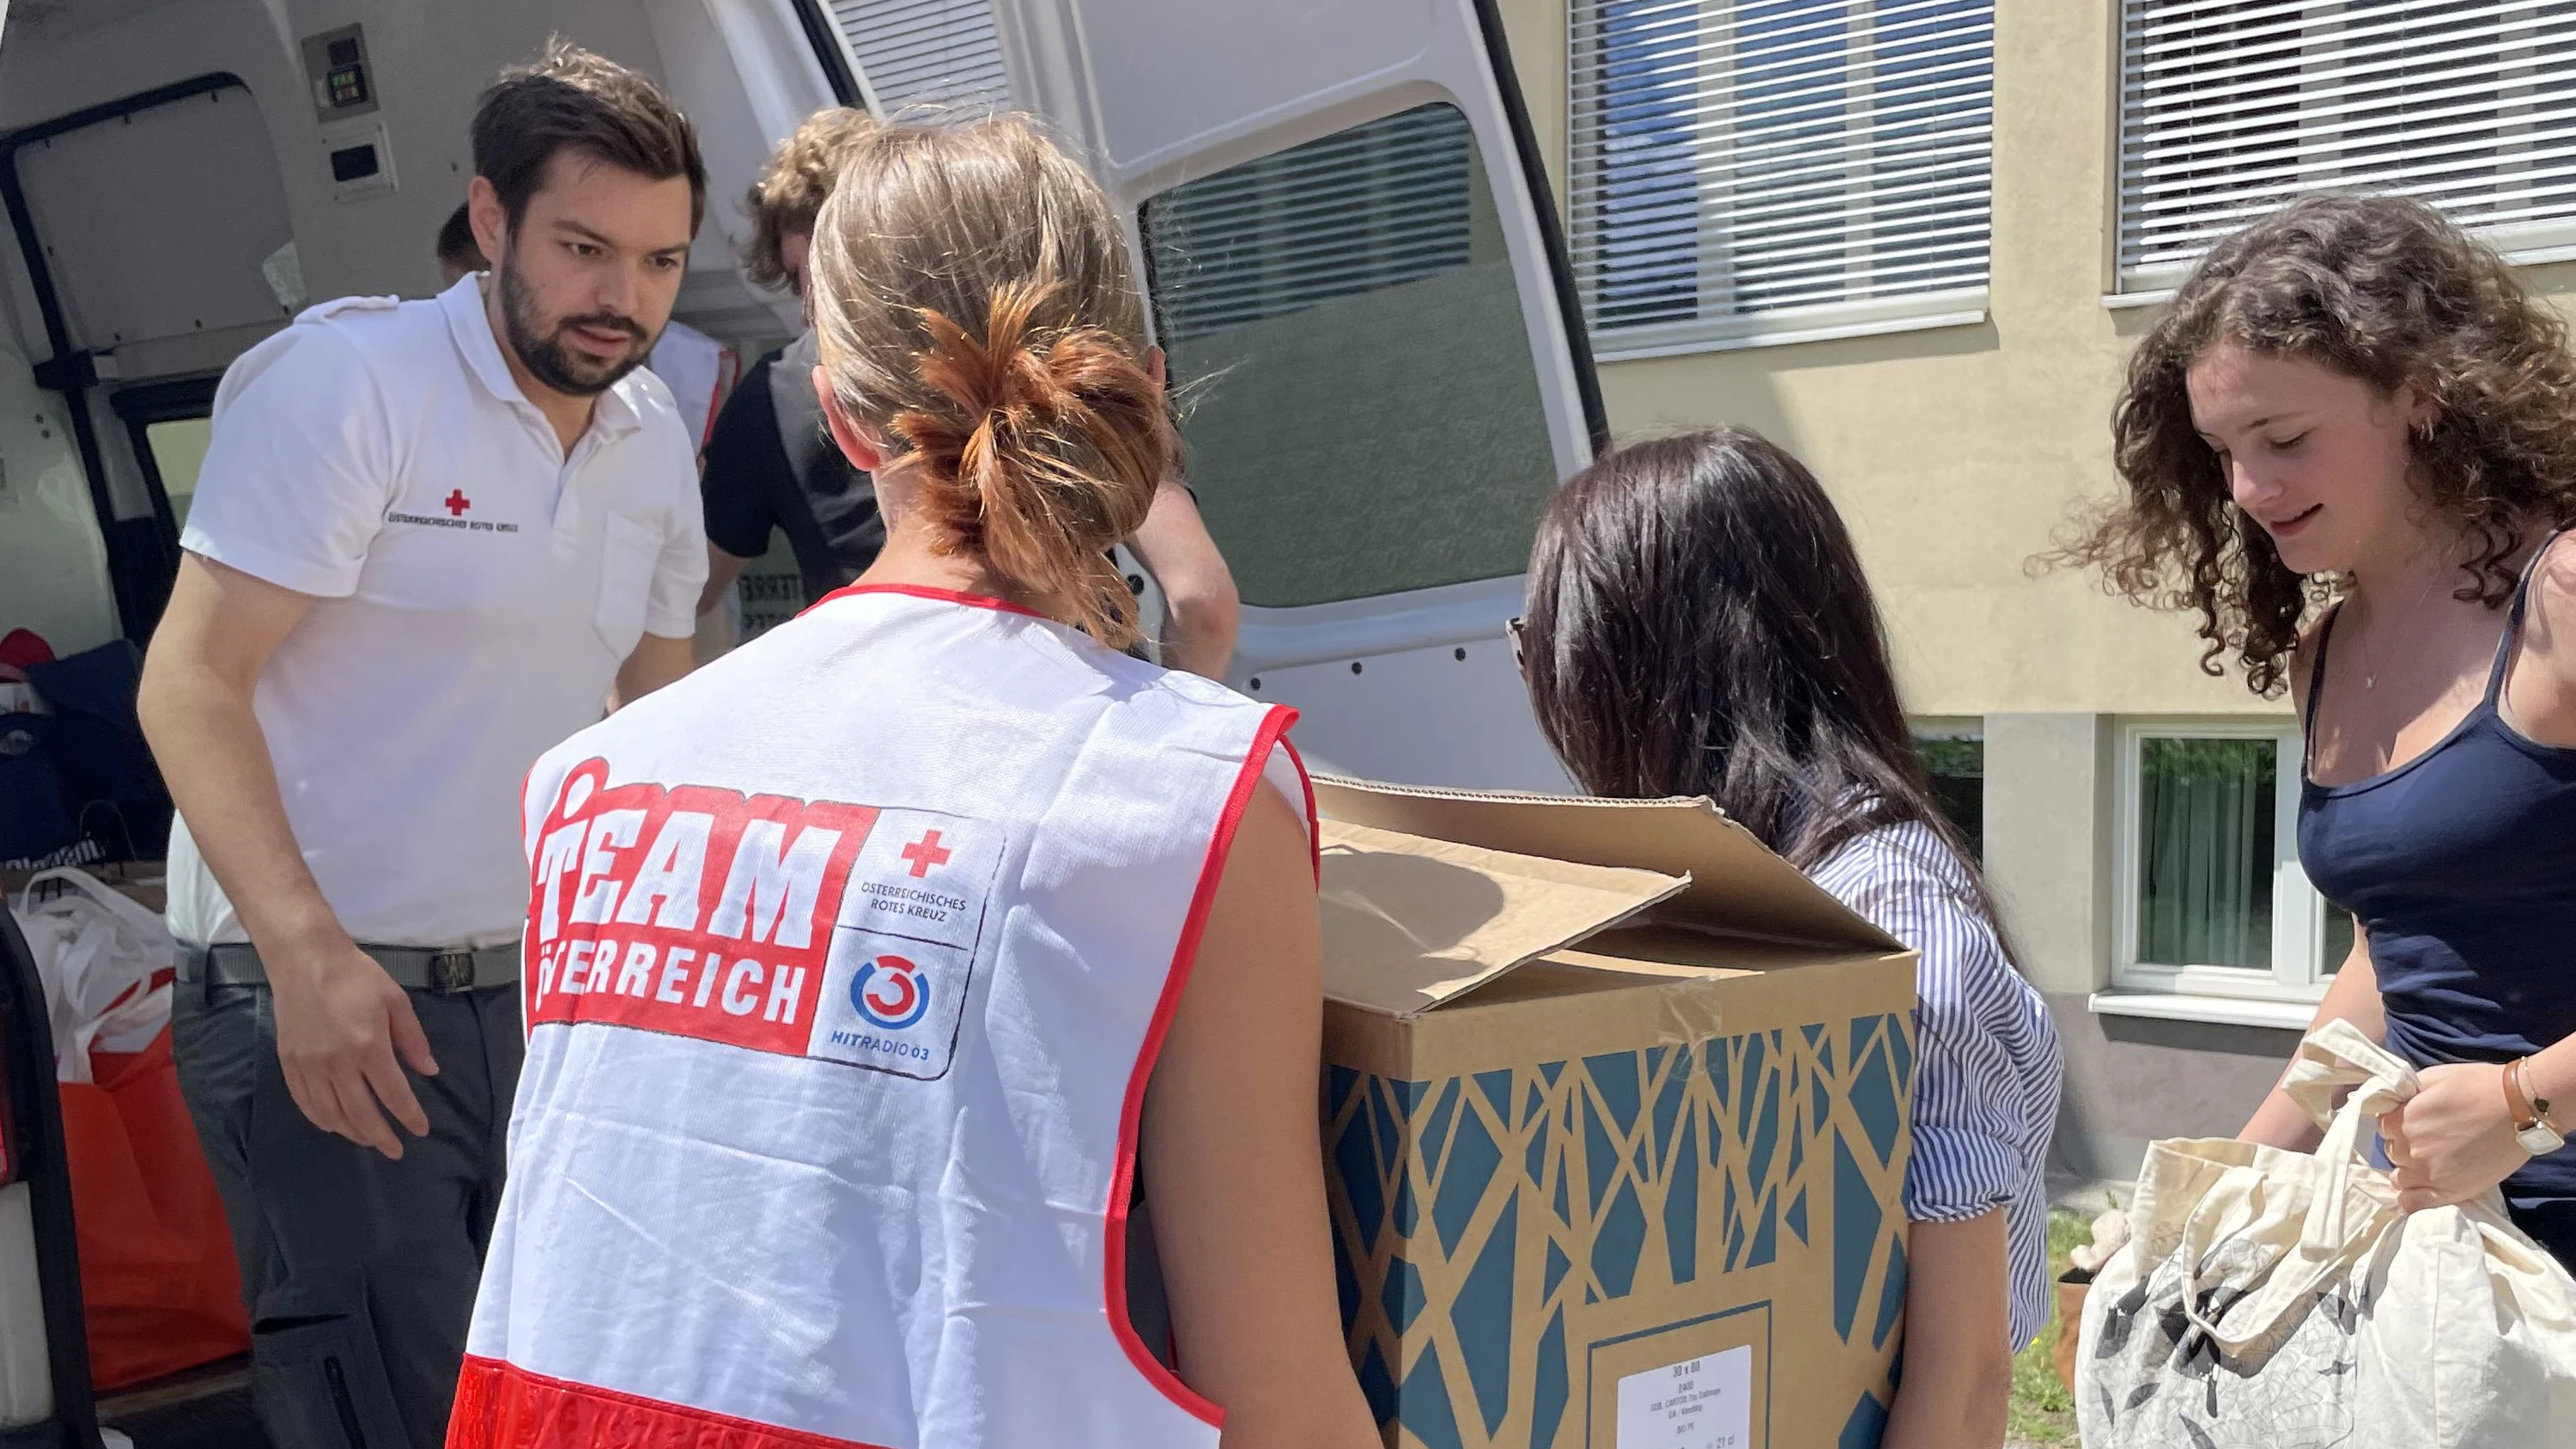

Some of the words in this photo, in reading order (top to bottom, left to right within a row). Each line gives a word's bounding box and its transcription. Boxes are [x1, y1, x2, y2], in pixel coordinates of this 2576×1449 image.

[537, 809, 843, 950] TEAM
[871, 898, 906, 914] ROTES
[907, 904, 948, 922] KREUZ
[830, 1031, 909, 1056] HITRADIO
